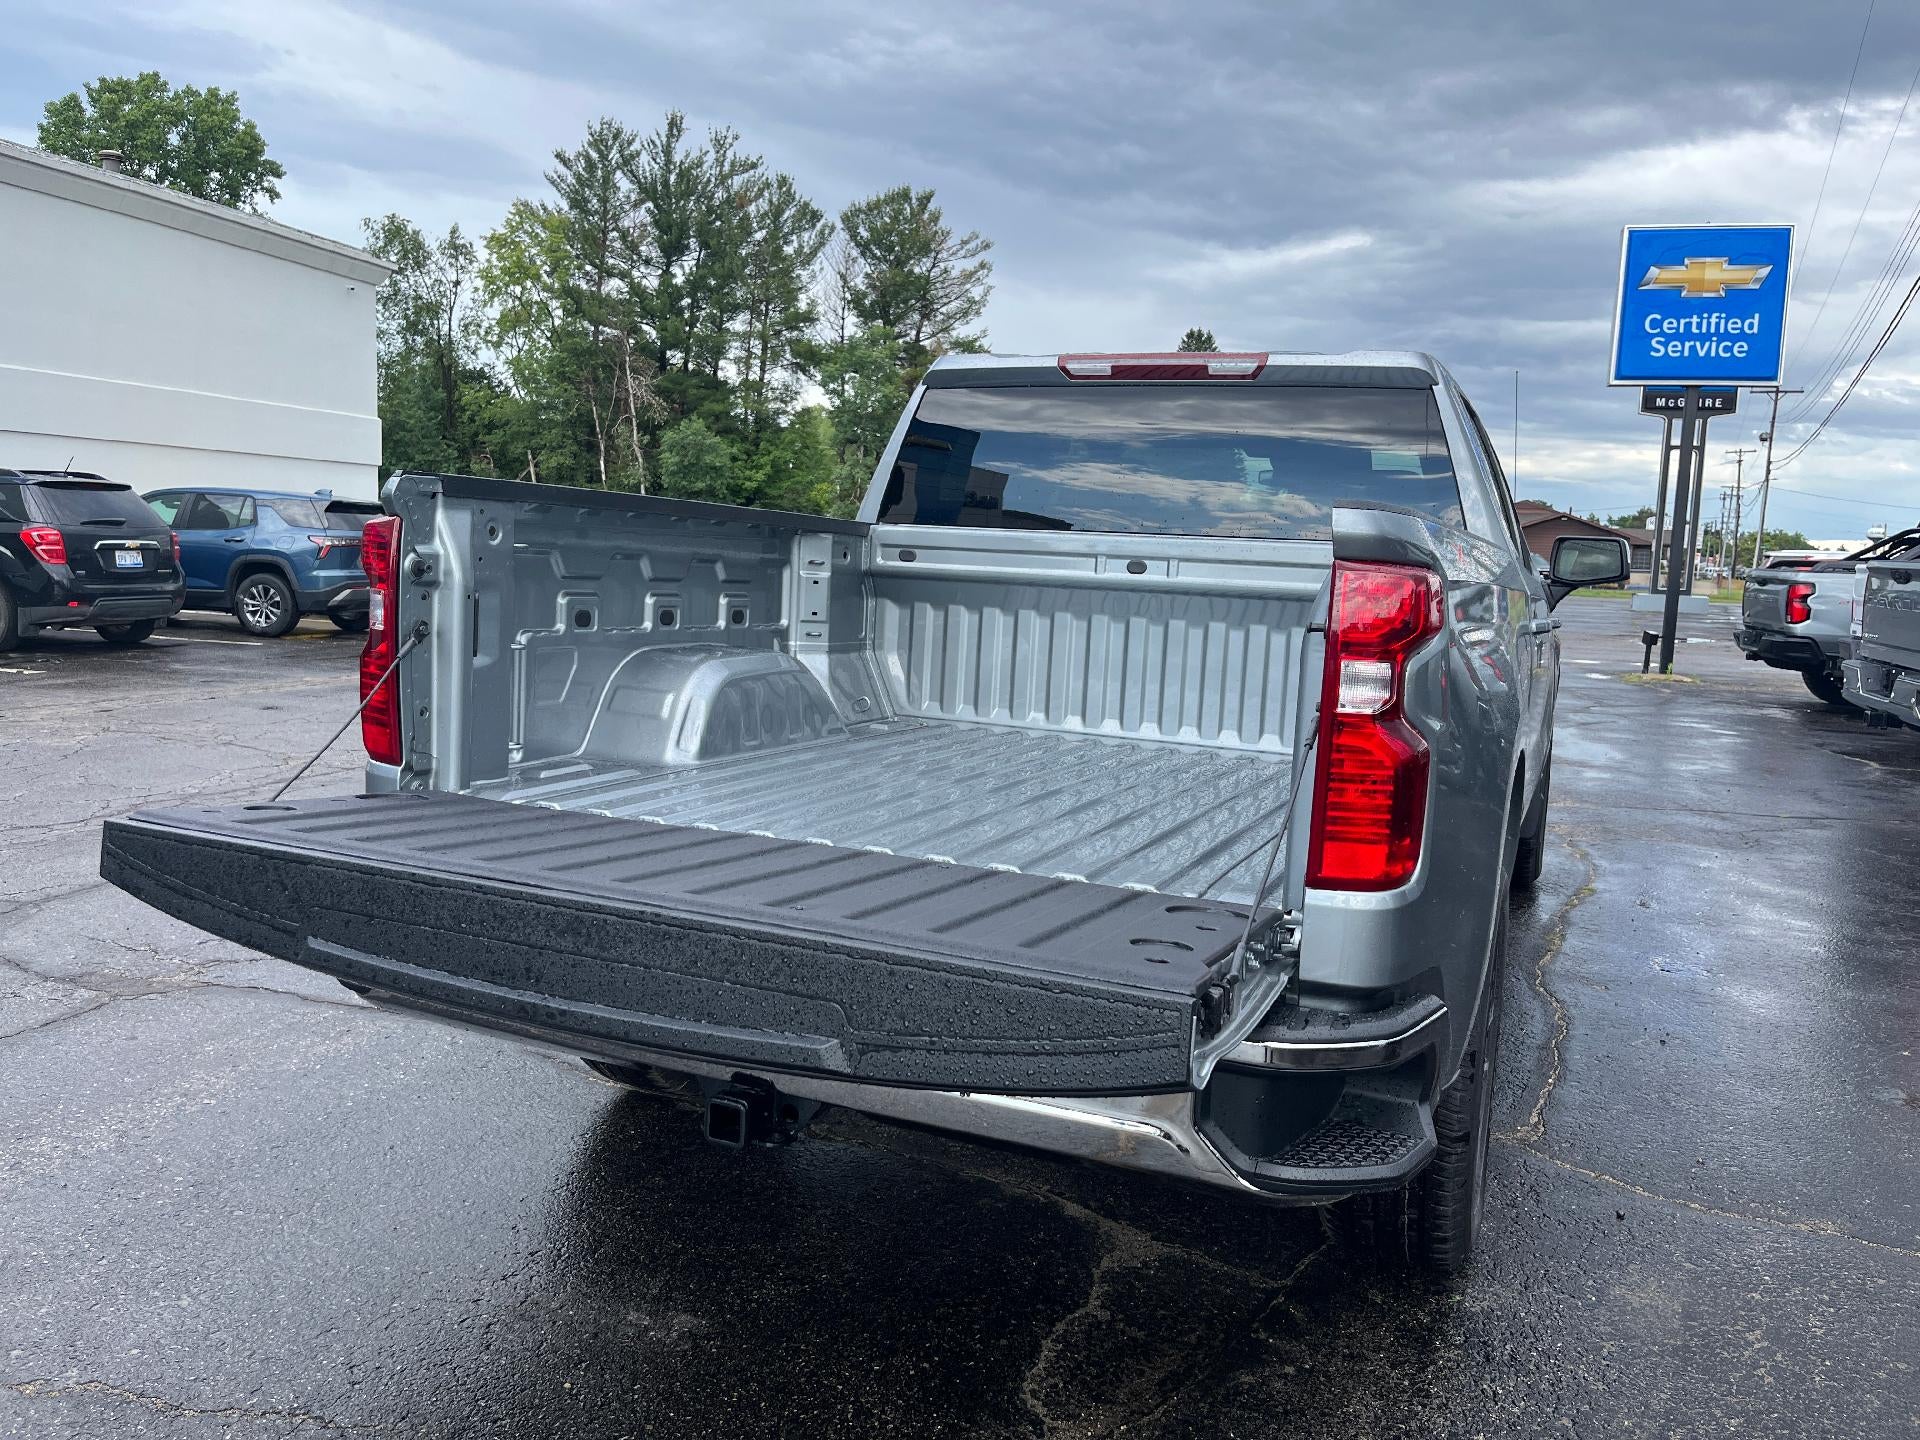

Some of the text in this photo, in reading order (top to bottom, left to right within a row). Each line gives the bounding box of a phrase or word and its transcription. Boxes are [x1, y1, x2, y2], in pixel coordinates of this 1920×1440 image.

[1644, 313, 1760, 334] Certified
[1650, 337, 1749, 358] Service
[1655, 397, 1723, 408] McGIRE
